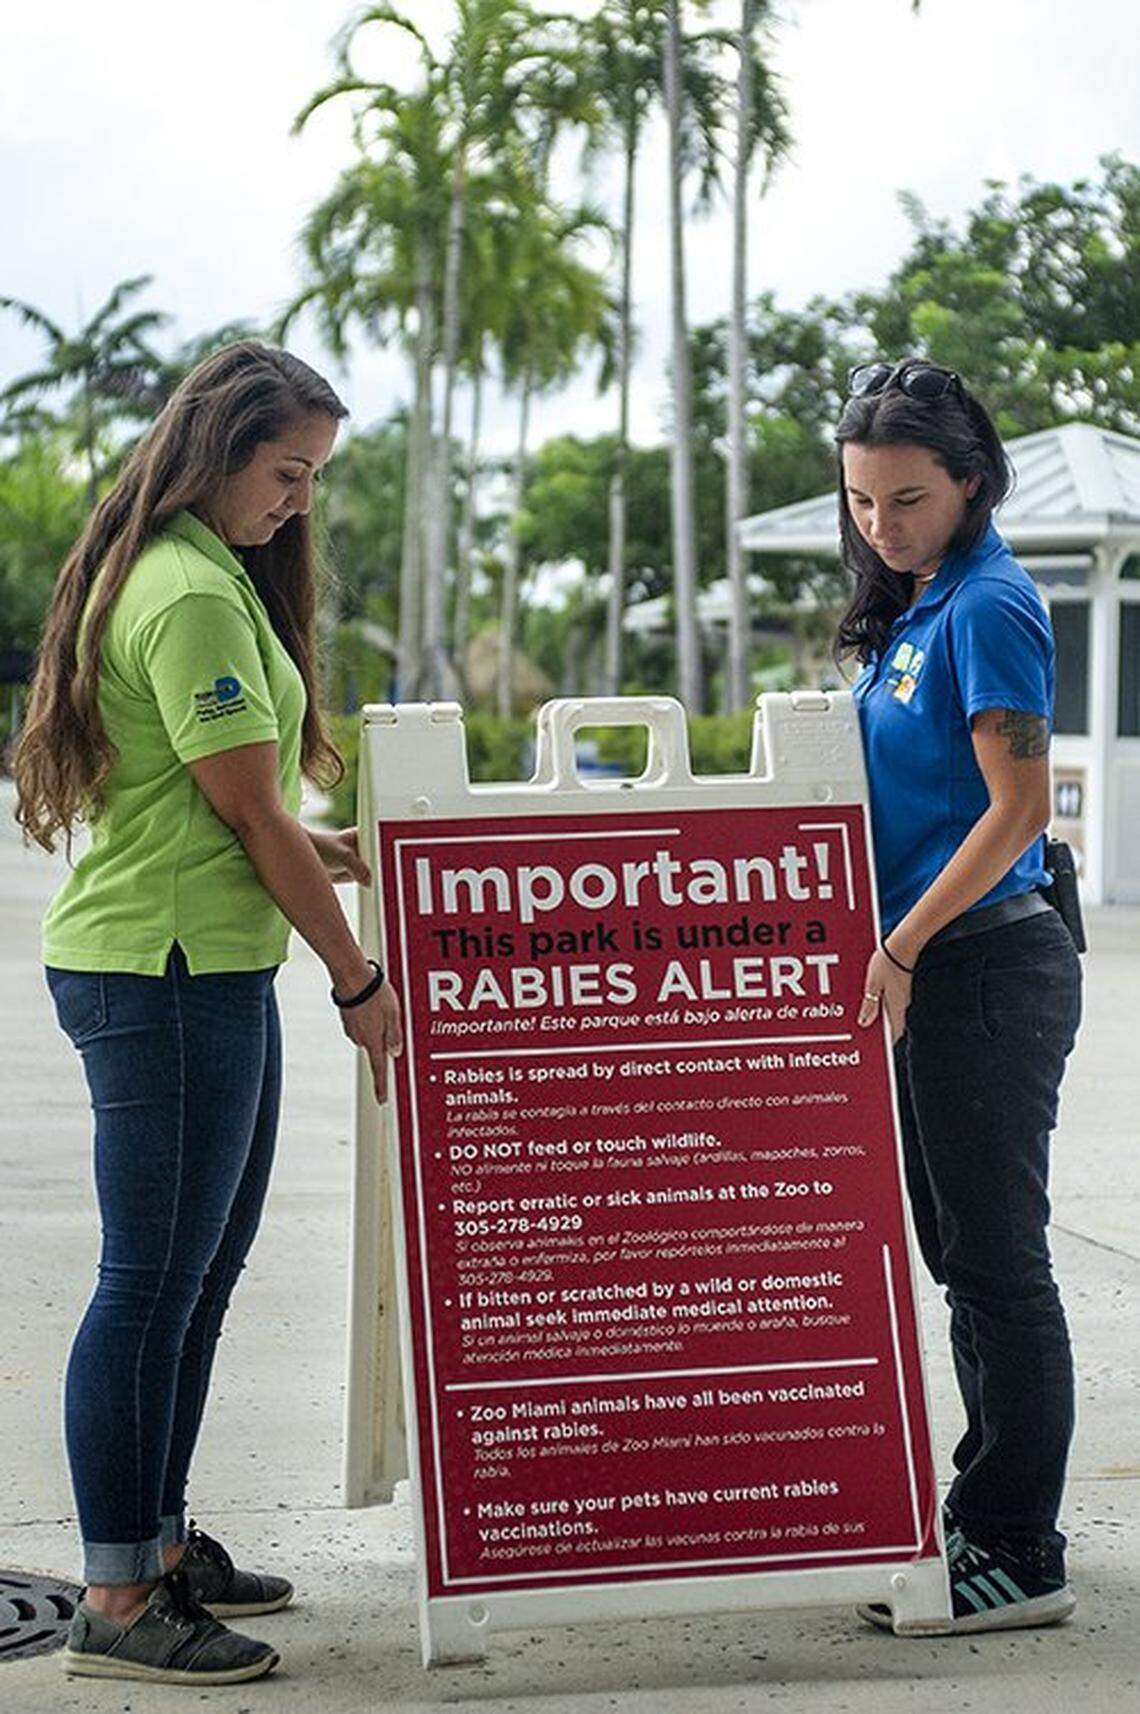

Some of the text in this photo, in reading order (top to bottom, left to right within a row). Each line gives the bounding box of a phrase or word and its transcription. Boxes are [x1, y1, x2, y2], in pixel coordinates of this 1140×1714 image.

[415, 842, 833, 923] Important!
[432, 916, 826, 961] This park is under a
[427, 954, 839, 1011] RABIES ALERT
[430, 1002, 843, 1036] ¡Importante! Este parque está bajo alerta de rabia
[444, 1050, 860, 1084] Rabies is spread by direct contact with infected
[445, 1088, 518, 1105] animals.
[446, 1111, 462, 1122] La
[502, 1108, 516, 1119] se
[519, 1104, 576, 1119] contagia
[579, 1105, 588, 1115] a
[656, 1098, 714, 1111] contacto
[716, 1096, 763, 1109] directo
[765, 1095, 789, 1107] con
[450, 1132, 721, 1159] DO NOT feed or touch wildlife.
[453, 1180, 833, 1216] Report erratic or sick animals at the Zoo to
[454, 1214, 583, 1236] 305-278-4929
[459, 1270, 843, 1307] If bitten or scratched by a wild or domestic
[460, 1294, 834, 1330] animal seek immediate medical attention.
[469, 1380, 865, 1421] Zoo Miami animals have all been vaccinated
[471, 1421, 604, 1446] against rabies.
[621, 1437, 650, 1452] Zoo
[477, 1478, 839, 1518] Make sure your pets have current rabies
[478, 1520, 599, 1542] vaccinations.
